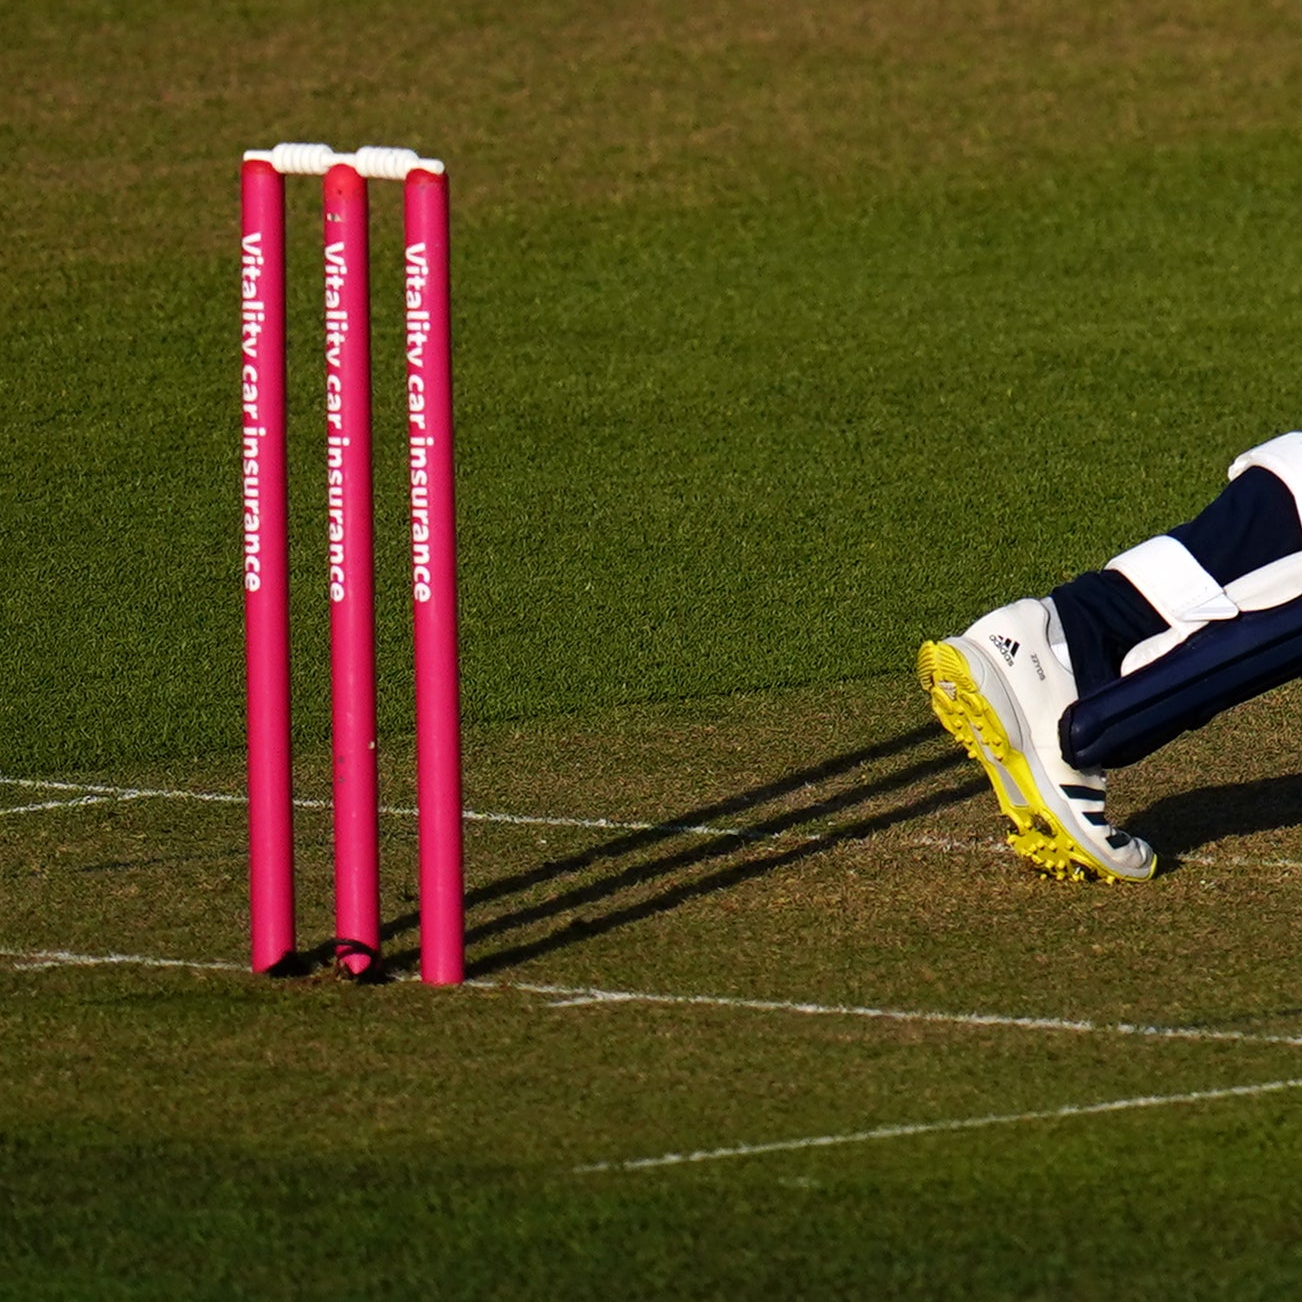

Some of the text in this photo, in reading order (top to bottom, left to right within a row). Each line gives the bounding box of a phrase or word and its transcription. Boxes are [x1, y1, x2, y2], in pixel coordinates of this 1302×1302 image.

[241, 232, 266, 592] Vitality car insurance
[324, 242, 350, 603] Vitality car insurance
[404, 242, 434, 603] Vitality car insurance
[988, 634, 1014, 667] adidas
